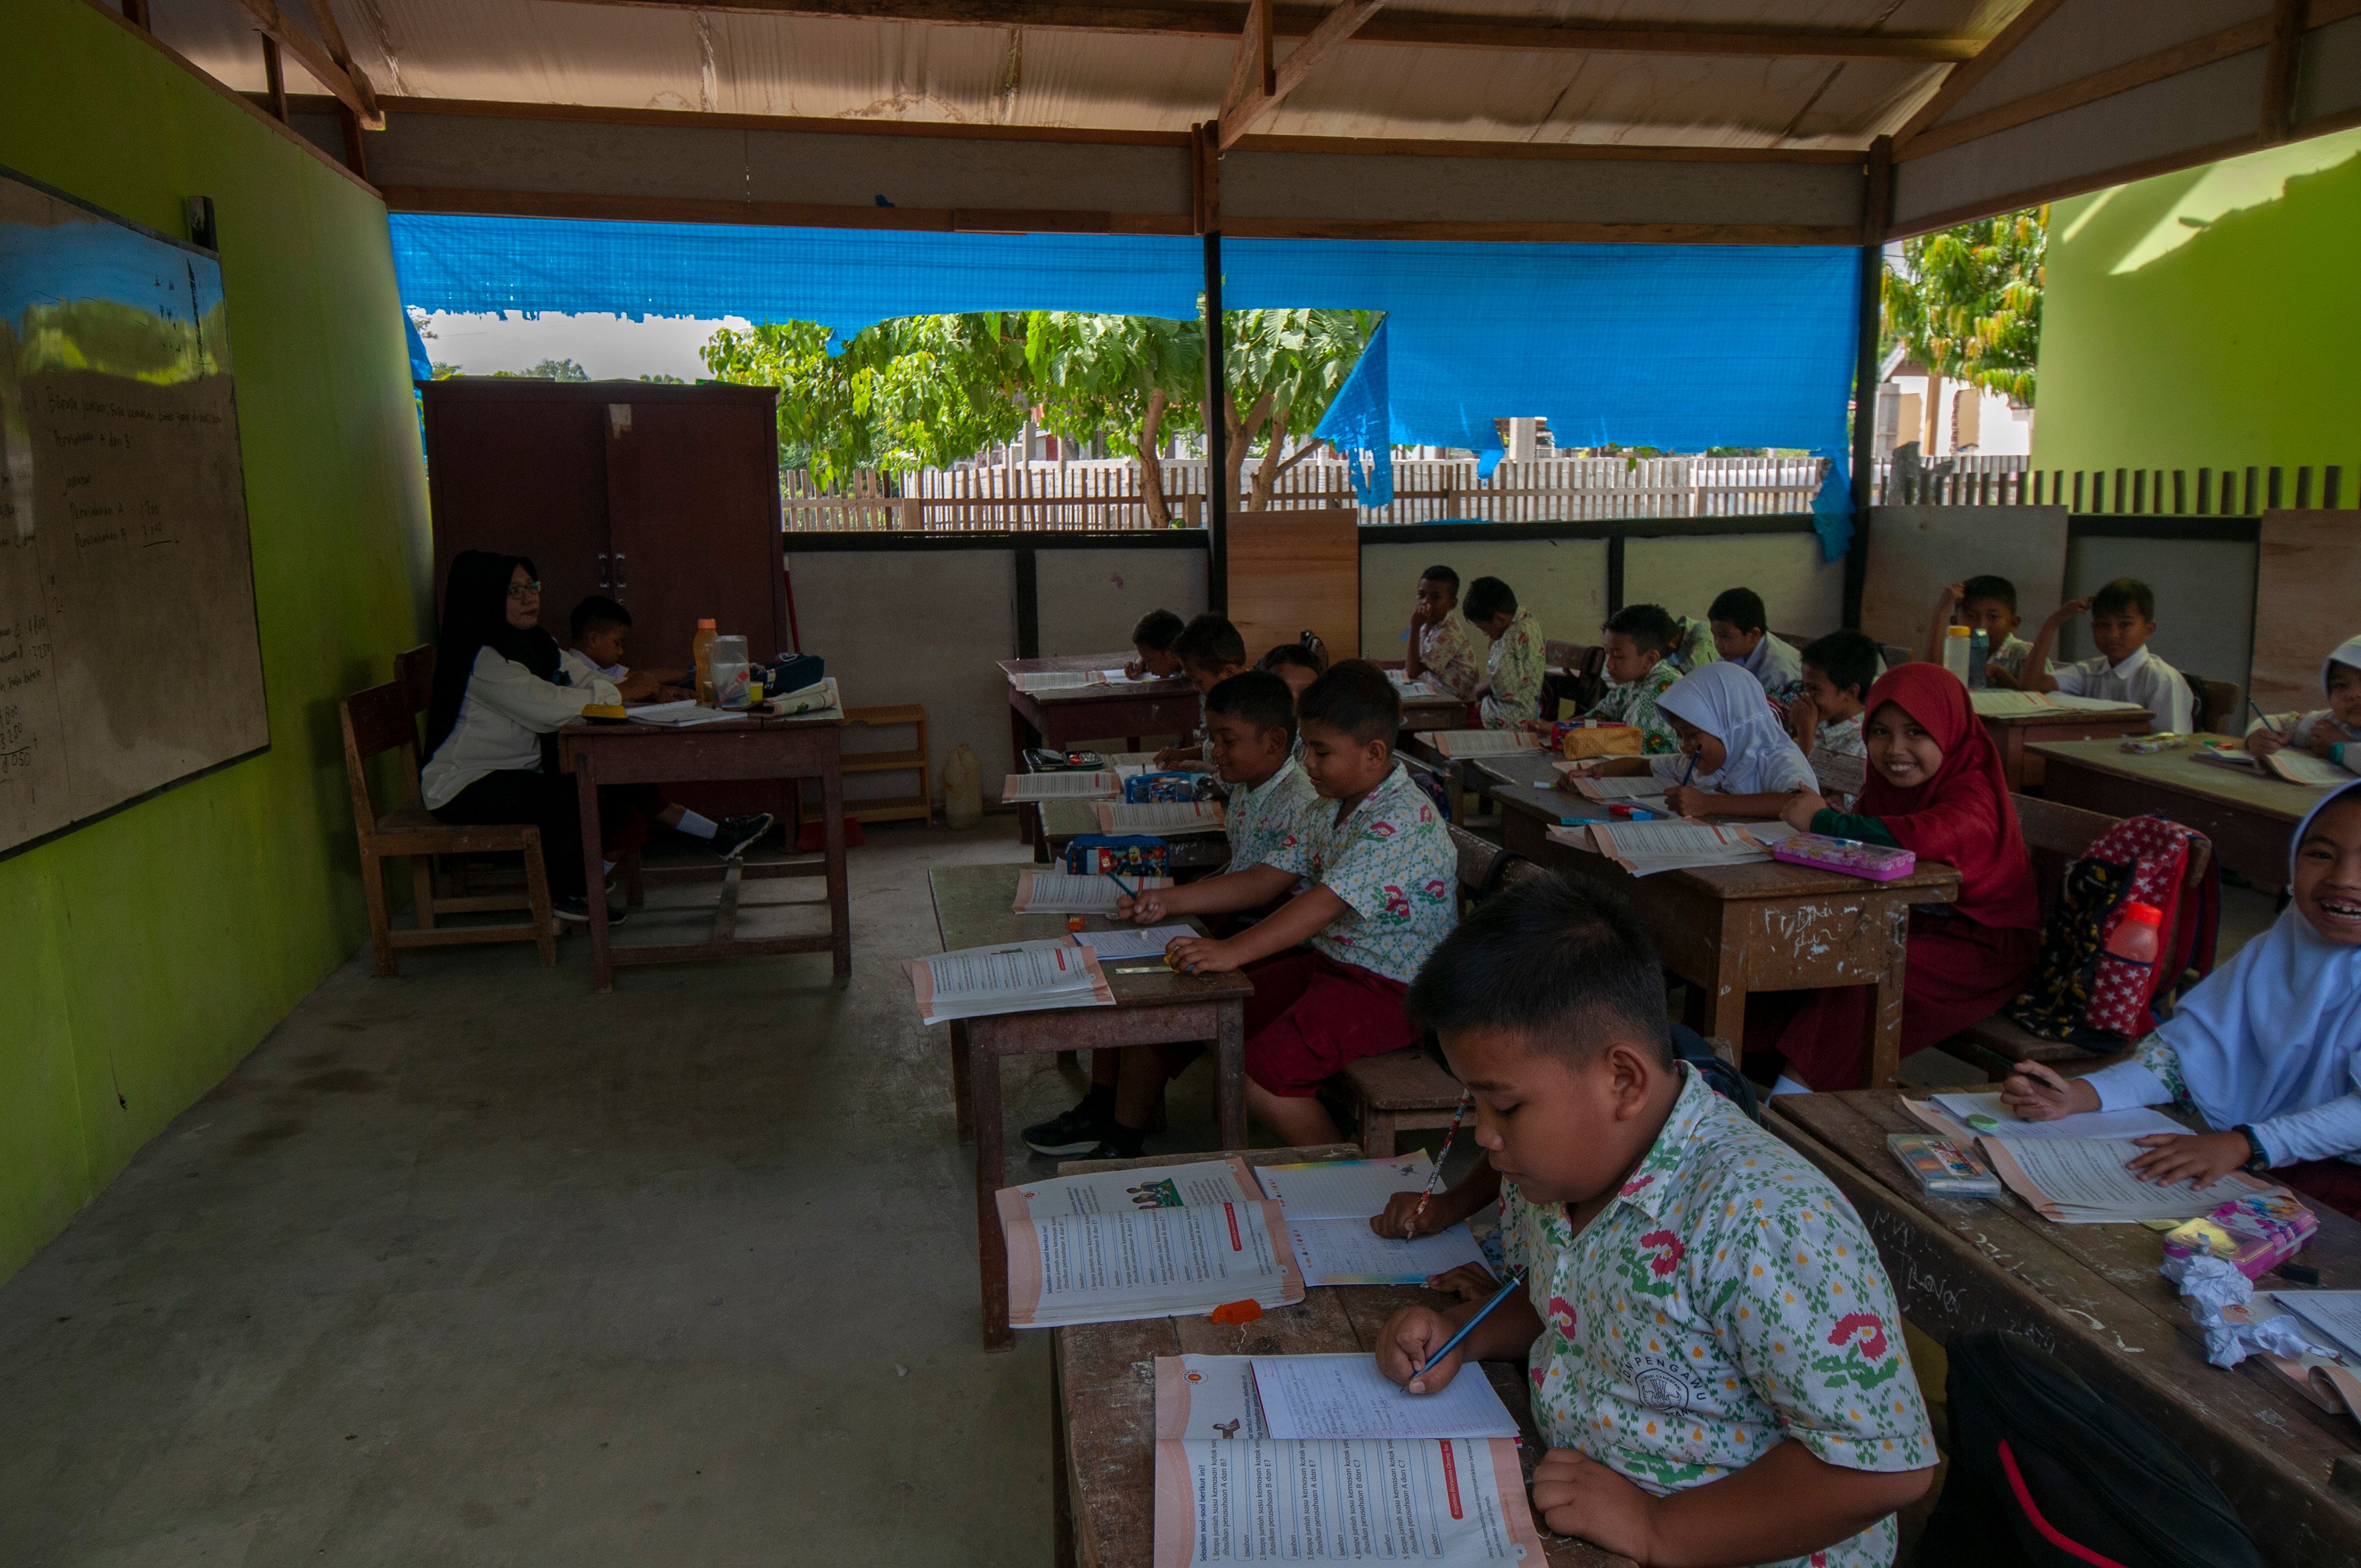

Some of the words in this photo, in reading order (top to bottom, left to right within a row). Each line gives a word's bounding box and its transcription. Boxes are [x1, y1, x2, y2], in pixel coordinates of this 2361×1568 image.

[1623, 1362, 1634, 1386] SDN
[1634, 1357, 1706, 1400] PENGAWU
[1300, 1468, 1308, 1498] kemasan
[1345, 1468, 1353, 1498] kemasan
[1391, 1469, 1399, 1498] kemasan
[1447, 1469, 1456, 1492] Bersama
[1266, 1490, 1275, 1527] perusahaan
[1312, 1490, 1322, 1526] perusahaan
[1358, 1490, 1369, 1526] perusahaan
[1404, 1491, 1415, 1526] perusahaan
[1451, 1493, 1459, 1514] Kegiatan
[1212, 1516, 1220, 1536] jumlah
[1257, 1516, 1266, 1536] jumlah
[1304, 1516, 1313, 1536] jumlah
[1350, 1516, 1361, 1536] jumlah
[1397, 1516, 1407, 1535] jumlah
[1306, 1537, 1314, 1555] Berapa
[1314, 1528, 1323, 1555] dihasilkan
[1353, 1537, 1362, 1554] Berapa
[1362, 1528, 1371, 1554] dihasilkan
[1384, 1534, 1394, 1556] Jawaban
[1401, 1537, 1410, 1554] Berapa
[1408, 1528, 1419, 1554] dihasilkan
[1431, 1534, 1441, 1555] Jawaban
